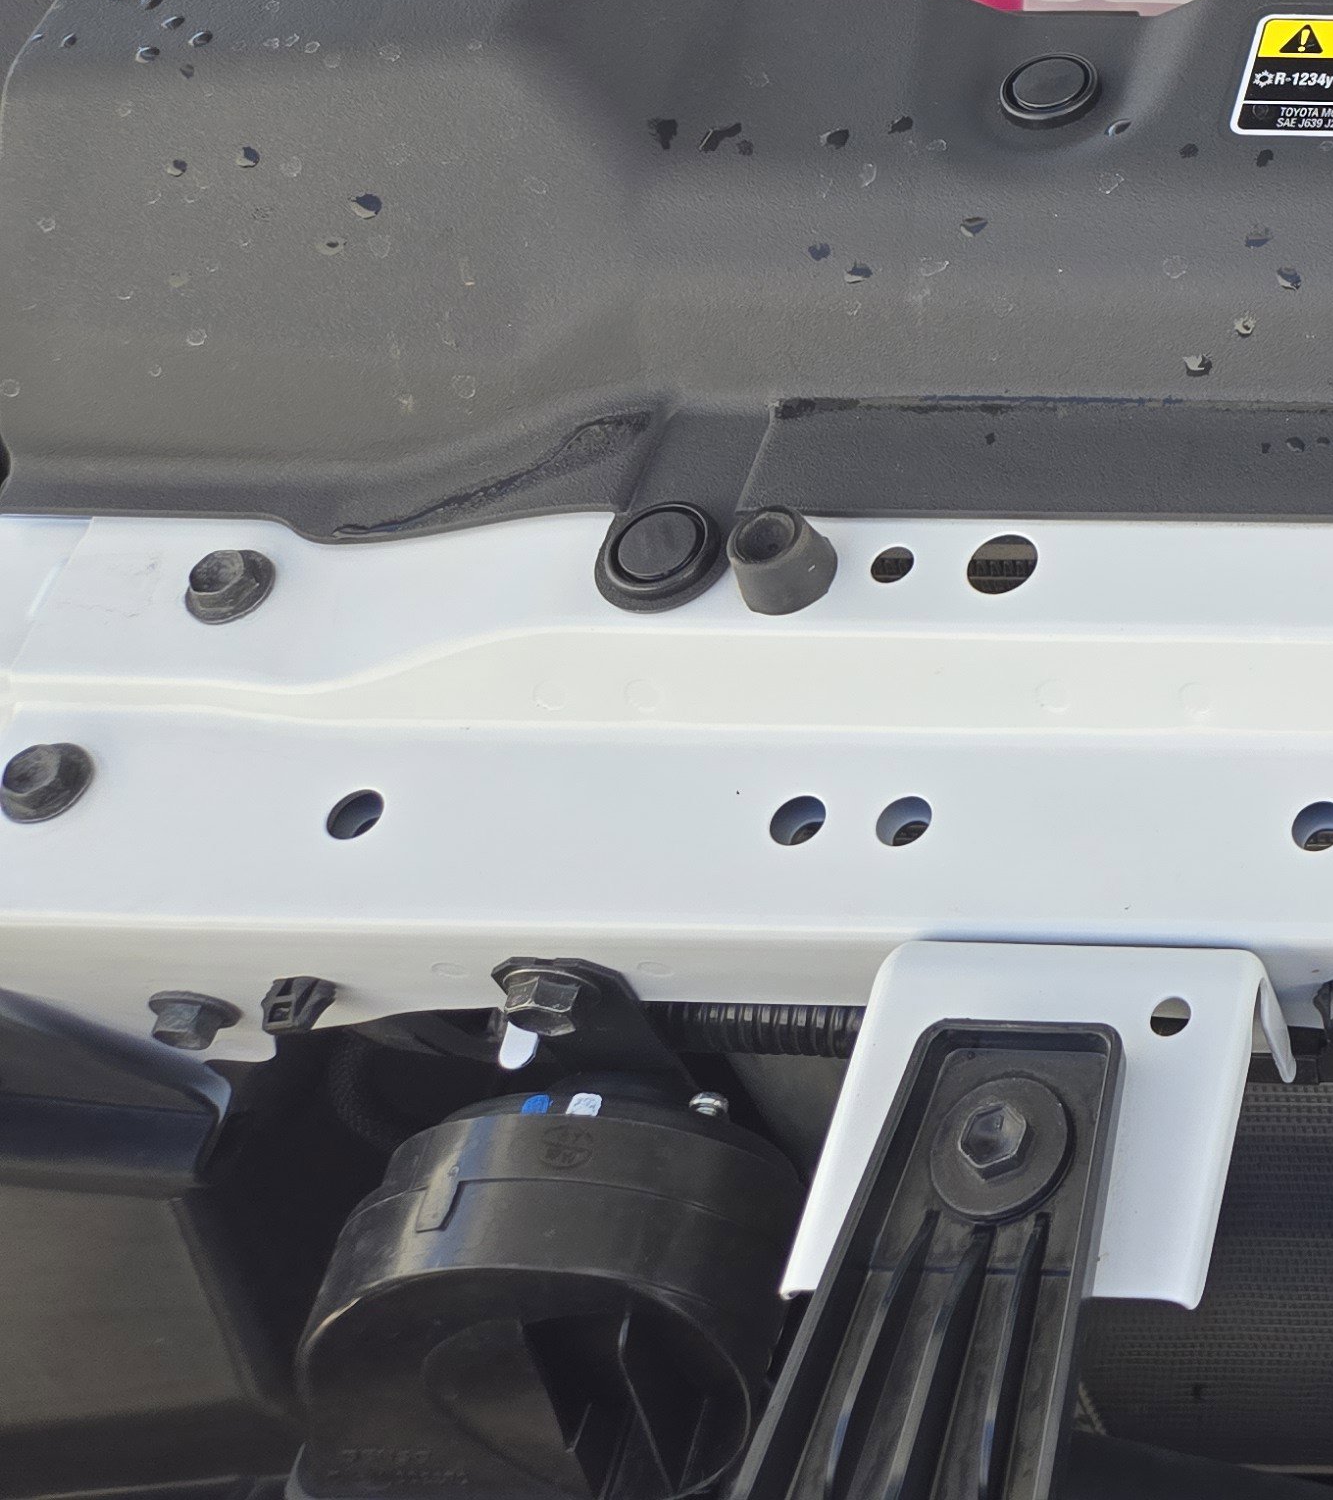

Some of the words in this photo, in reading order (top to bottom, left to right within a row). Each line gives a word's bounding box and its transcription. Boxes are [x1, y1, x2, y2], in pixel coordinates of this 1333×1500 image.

[1280, 107, 1319, 117] TOYOTA
[1276, 117, 1296, 128] SAE
[1297, 118, 1323, 128] J639
